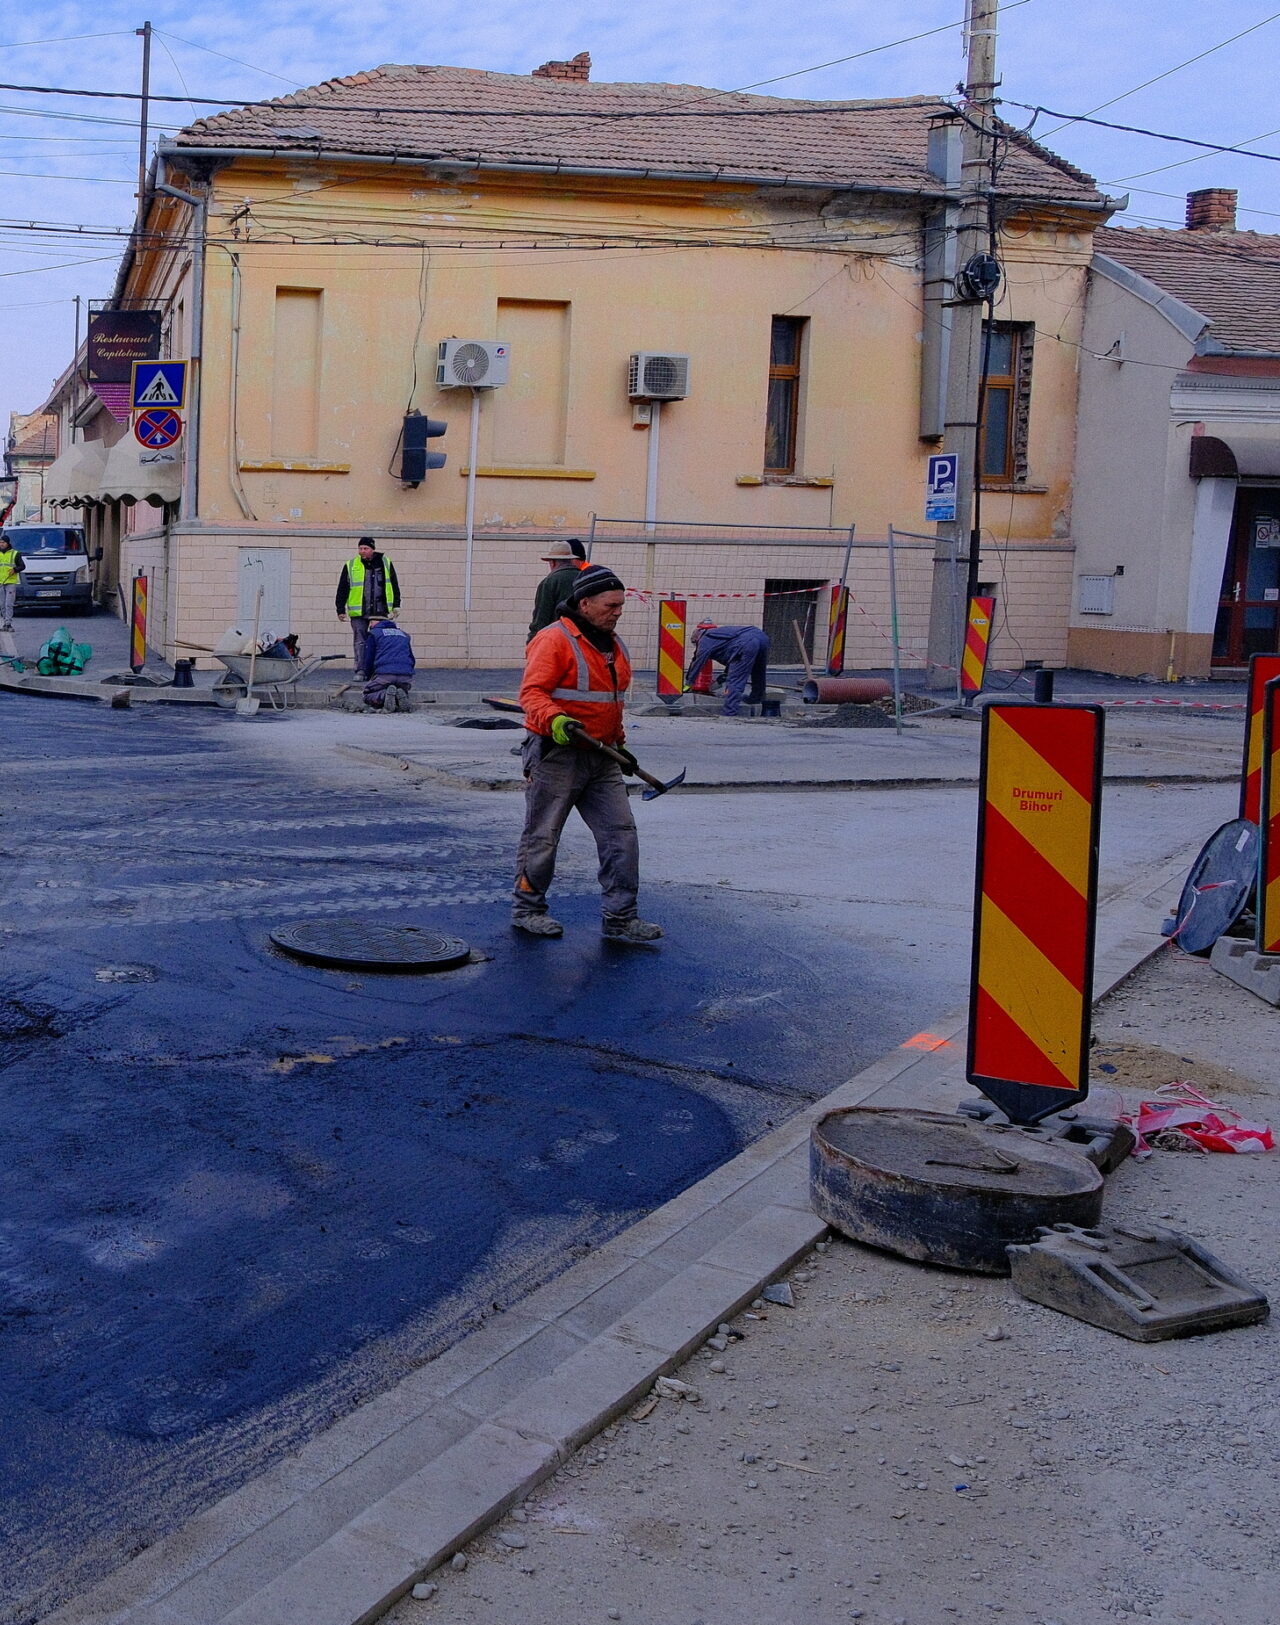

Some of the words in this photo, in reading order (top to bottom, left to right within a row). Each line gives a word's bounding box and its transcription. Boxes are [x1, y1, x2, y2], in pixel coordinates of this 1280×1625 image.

[93, 333, 154, 344] Restaurant
[97, 348, 147, 360] Capitolium
[934, 460, 952, 489] P
[1012, 787, 1063, 801] Drumuri
[1020, 800, 1054, 812] Bihor
